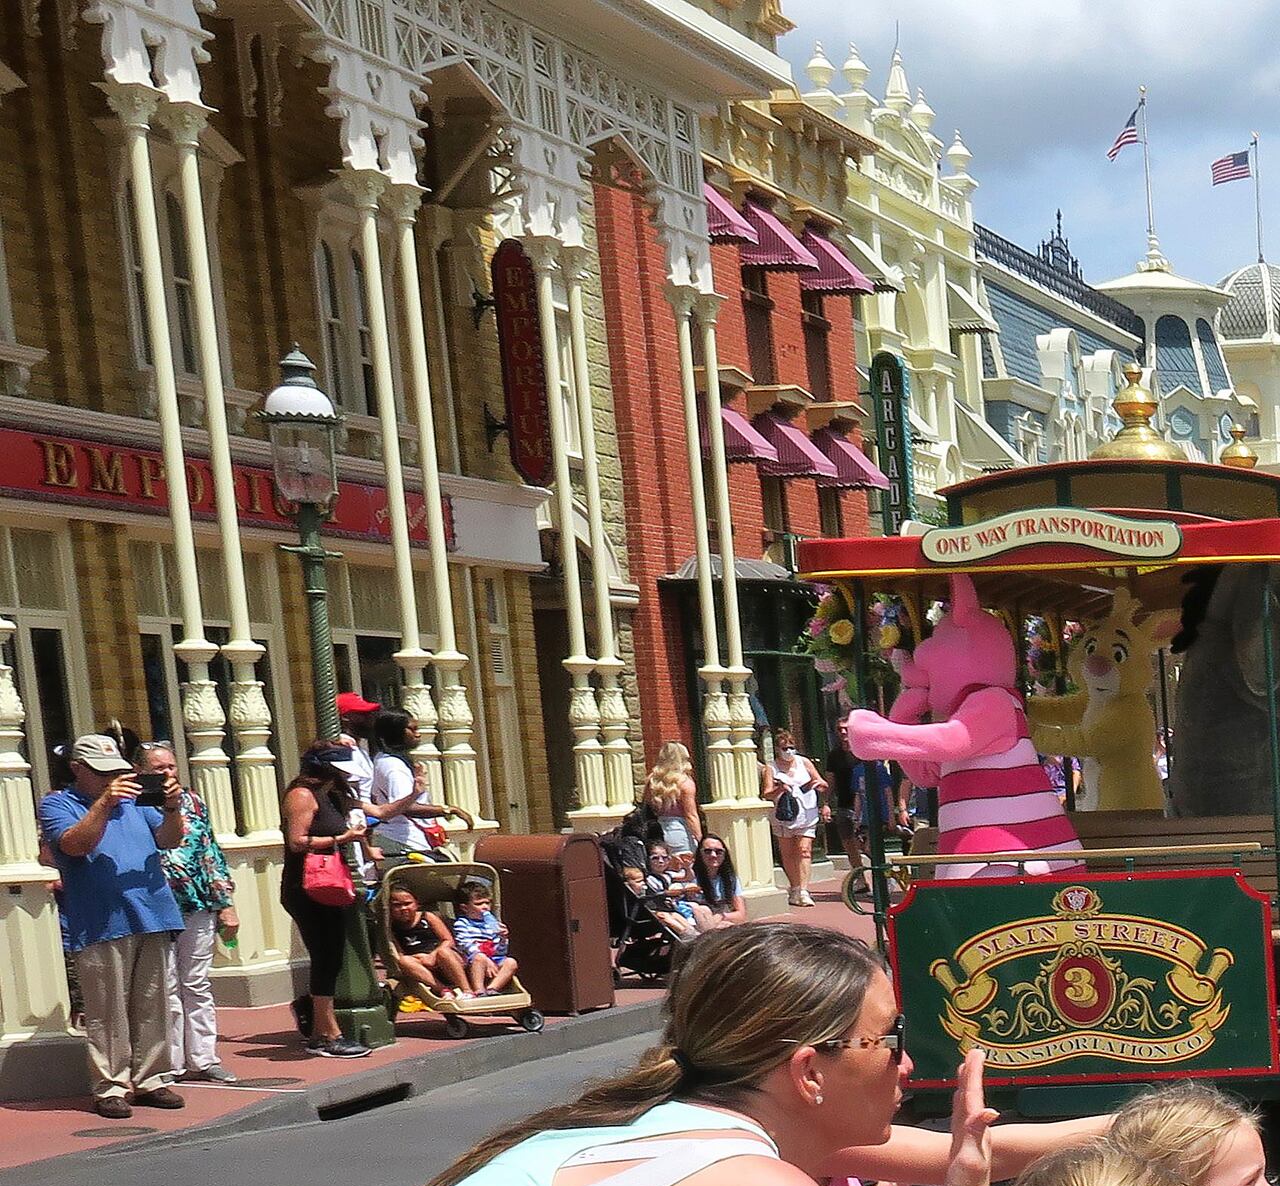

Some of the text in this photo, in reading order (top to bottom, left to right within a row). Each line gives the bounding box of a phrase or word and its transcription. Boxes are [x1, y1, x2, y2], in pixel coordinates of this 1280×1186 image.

[505, 267, 544, 458] EMPORIUM
[881, 370, 901, 535] ARCADE
[936, 516, 1165, 555] ONE WAY TRANSPORTATION
[977, 923, 1188, 960] MAIN STREET
[1063, 966, 1099, 1007] 3
